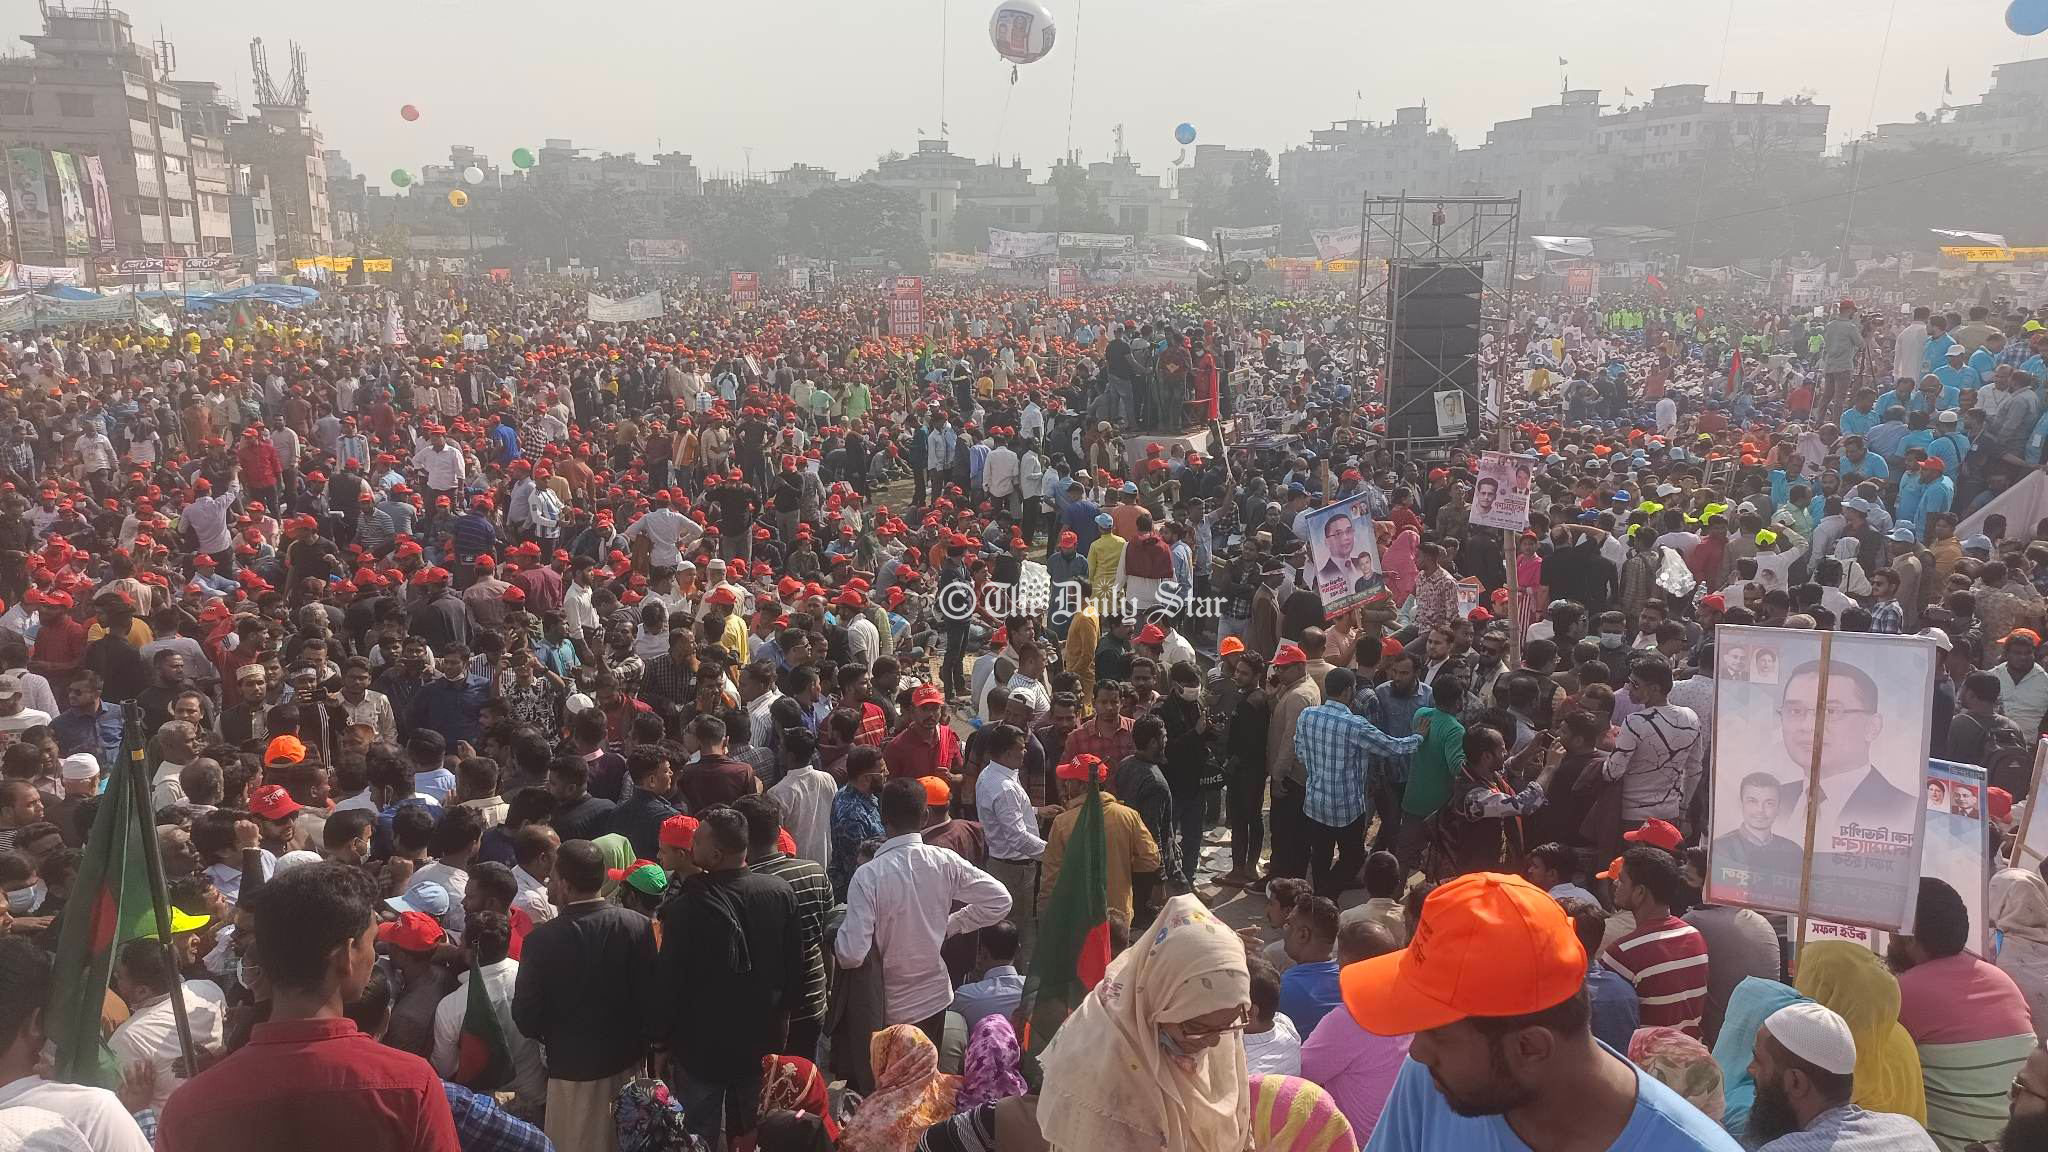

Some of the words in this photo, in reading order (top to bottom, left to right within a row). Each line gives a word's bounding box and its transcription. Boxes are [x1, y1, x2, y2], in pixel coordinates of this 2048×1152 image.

[1199, 773, 1223, 785] NIKE
[1811, 922, 1838, 937] সফল
[1840, 925, 1868, 941] হউক
